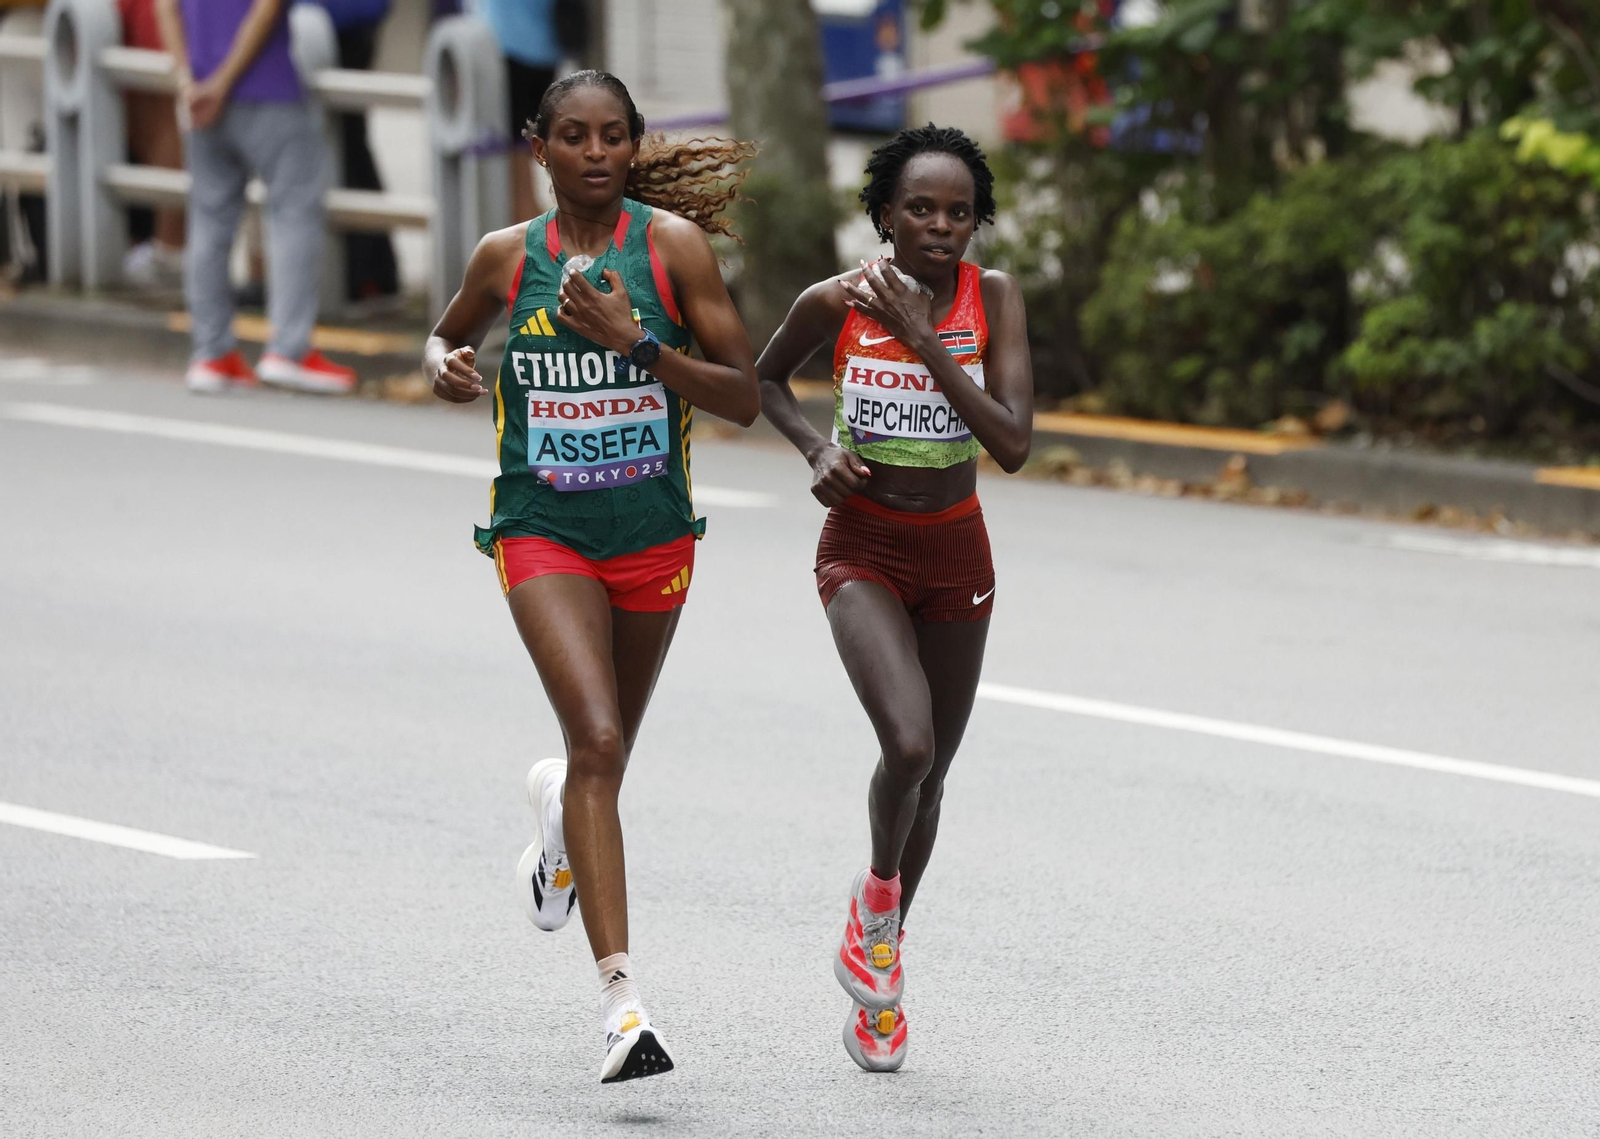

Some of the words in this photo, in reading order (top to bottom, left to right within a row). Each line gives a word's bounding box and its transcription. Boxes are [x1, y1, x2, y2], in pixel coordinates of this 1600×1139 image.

[847, 367, 943, 393] HON
[530, 395, 664, 420] HONDA
[848, 397, 967, 434] JEPCHIRCH
[535, 425, 661, 463] ASSEFA
